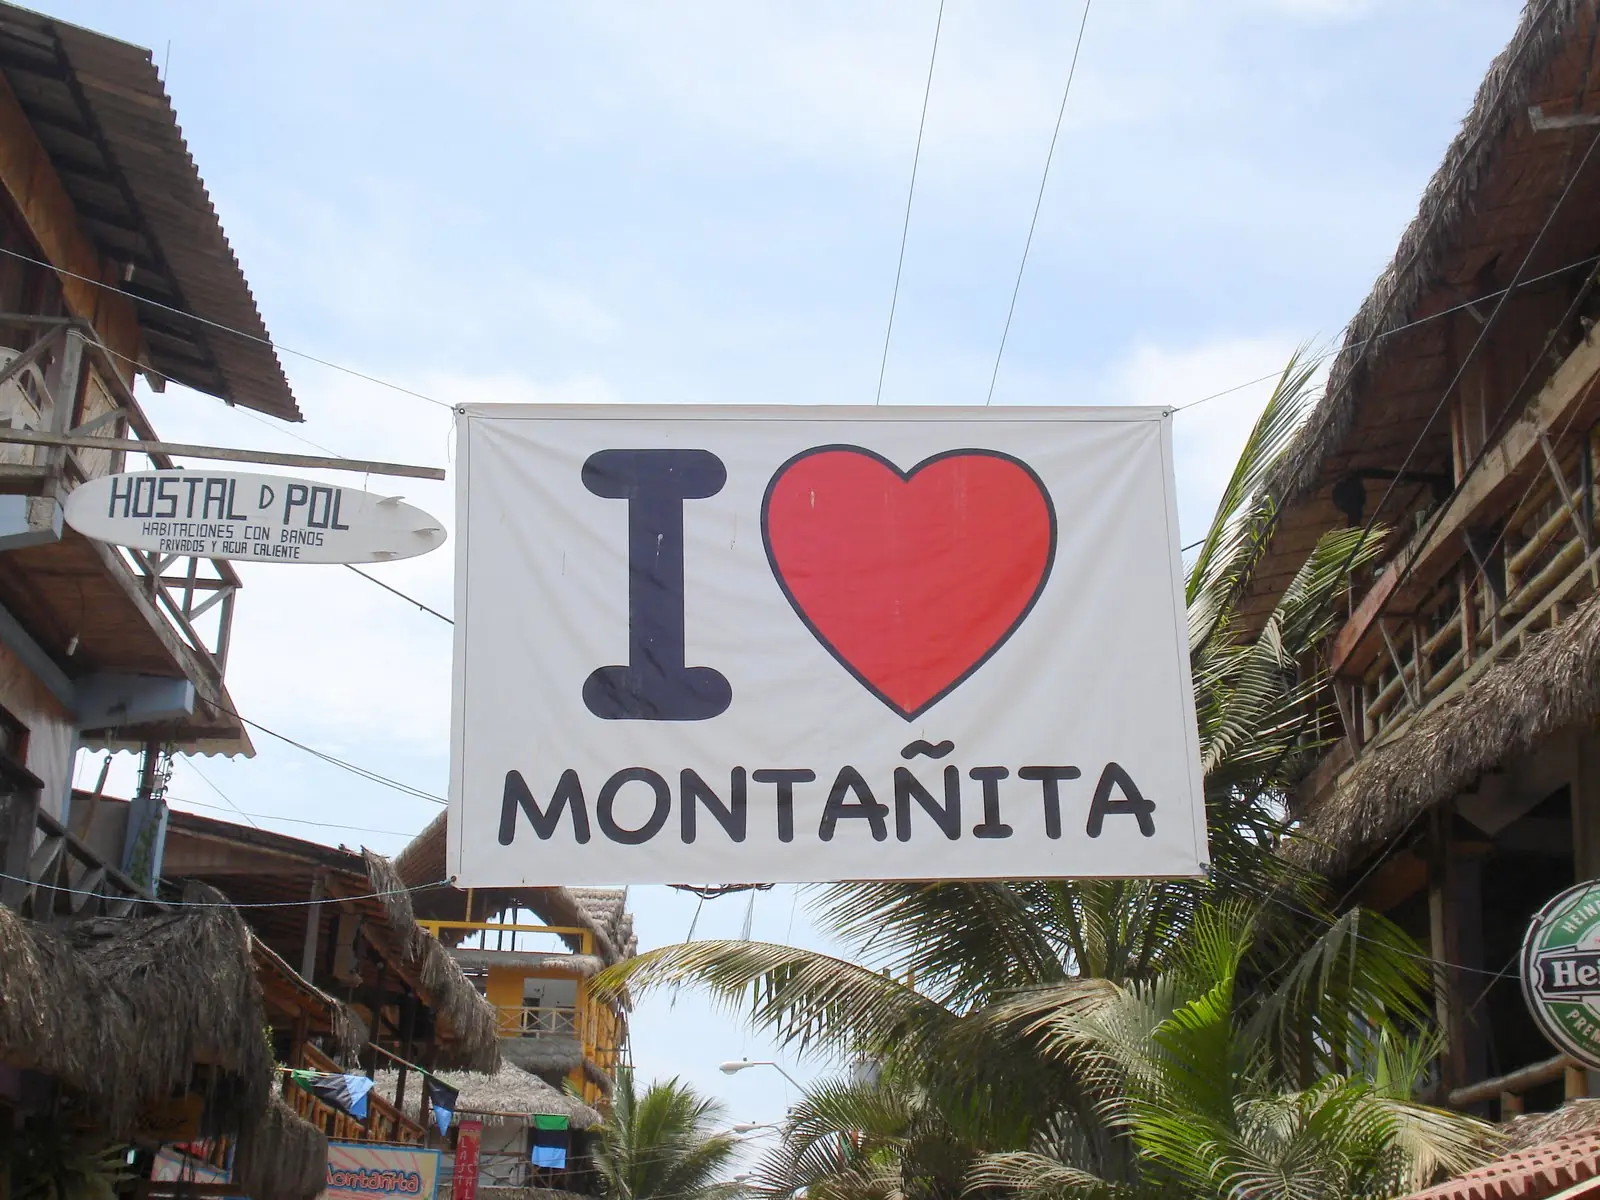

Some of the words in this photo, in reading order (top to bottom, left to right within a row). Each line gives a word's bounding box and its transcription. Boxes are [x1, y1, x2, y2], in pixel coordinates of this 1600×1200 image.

[108, 477, 247, 520] HOSTAL
[259, 484, 275, 509] D
[283, 483, 349, 530] POL
[142, 521, 234, 539] HABITACIONES
[244, 525, 270, 541] CON
[280, 528, 324, 547] BAÑOS
[160, 538, 205, 553] PRIVADOS
[211, 540, 218, 553] Y
[222, 540, 247, 554] AGUA
[253, 542, 300, 559] CALIENTE
[581, 448, 733, 721] I
[498, 739, 1157, 846] MONTAÑITA
